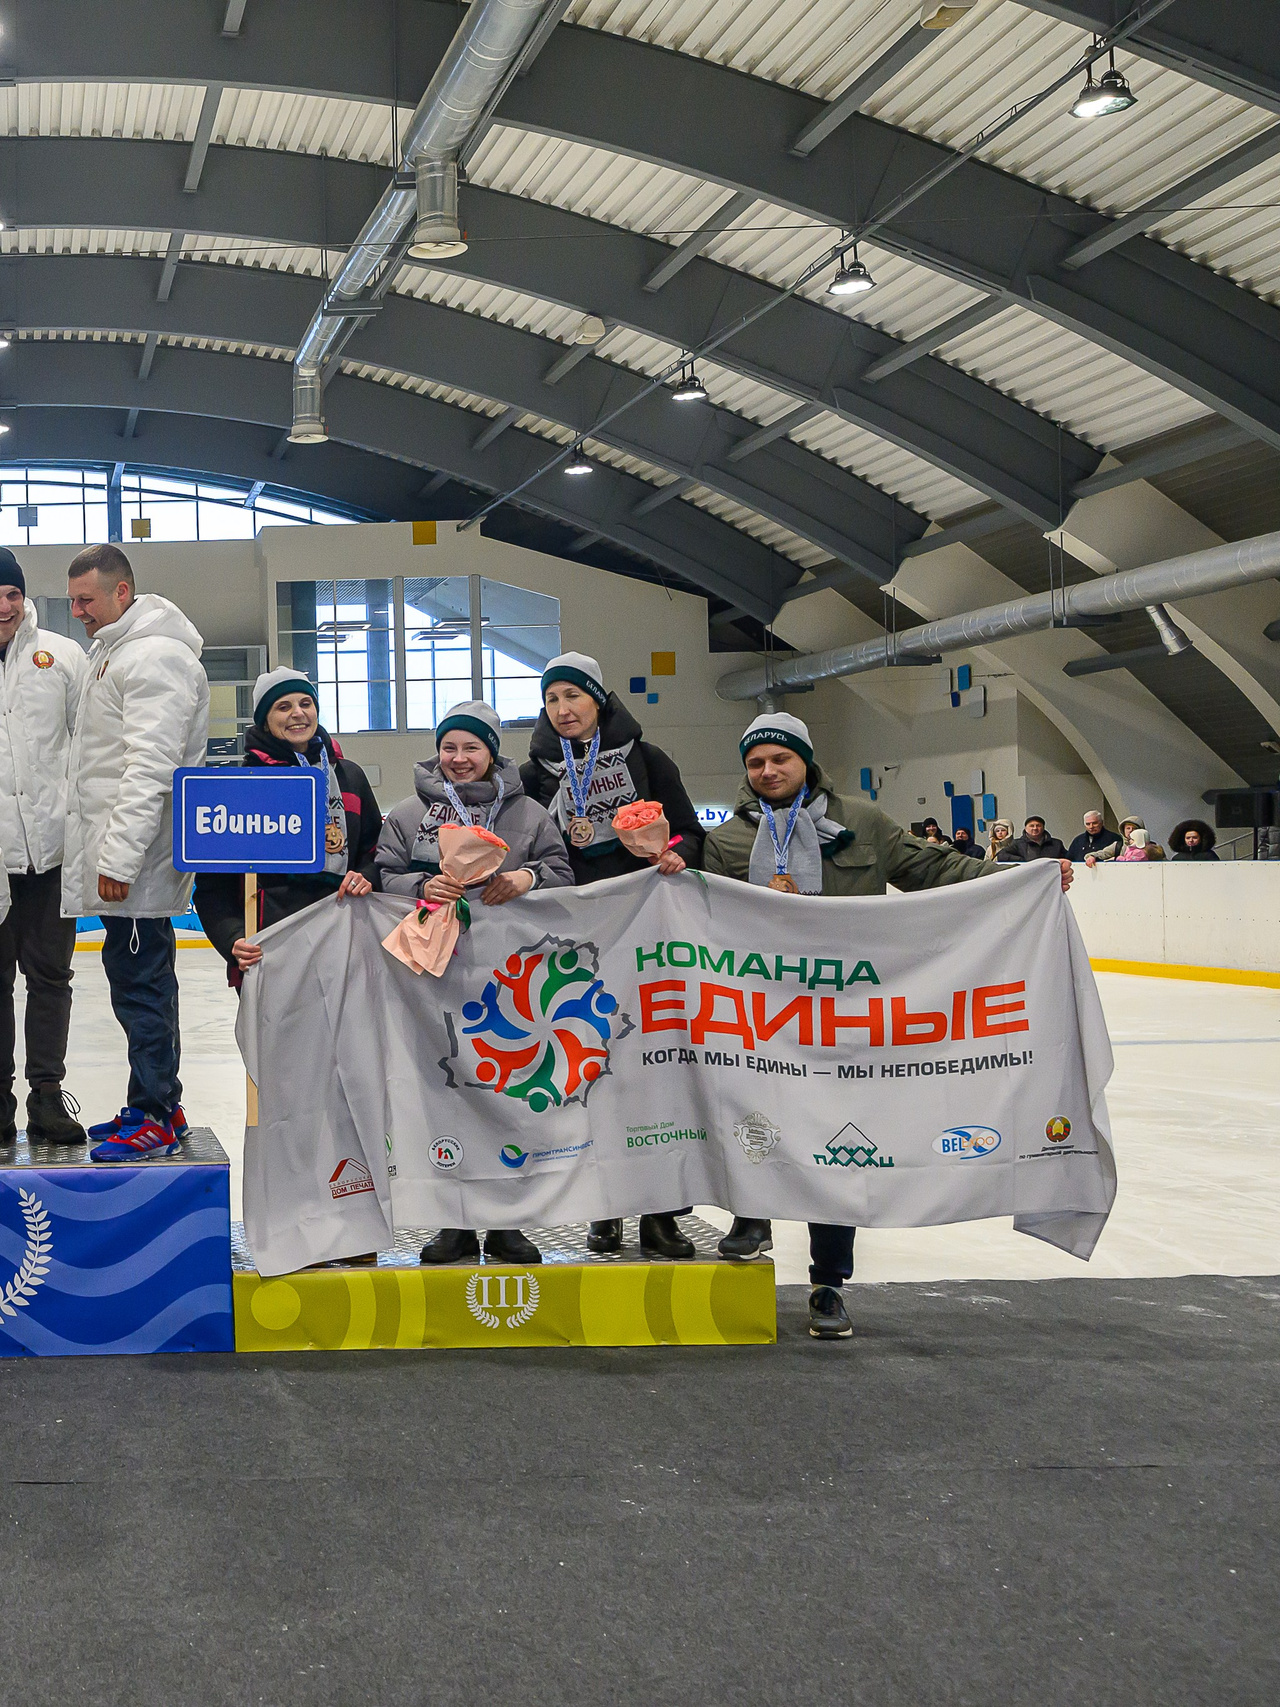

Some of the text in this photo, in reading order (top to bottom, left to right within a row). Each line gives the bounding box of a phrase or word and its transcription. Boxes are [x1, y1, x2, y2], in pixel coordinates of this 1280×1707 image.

[195, 804, 303, 835] Единые
[635, 940, 881, 991] КОМАНДА
[638, 979, 1030, 1051] ЕДИНЫЕ
[641, 1047, 699, 1067] КОГДА
[704, 1051, 740, 1067] МЫ
[745, 1054, 807, 1078] ЕДИНЫ
[837, 1063, 874, 1079] МЫ
[880, 1049, 1034, 1079] НЕПОБЕДИМЫ!
[626, 1121, 675, 1133] Торговый Дом
[626, 1127, 708, 1149] ВОСТОЧНЫЙ
[331, 1186, 348, 1197] ДОМ
[478, 1275, 528, 1308] III
